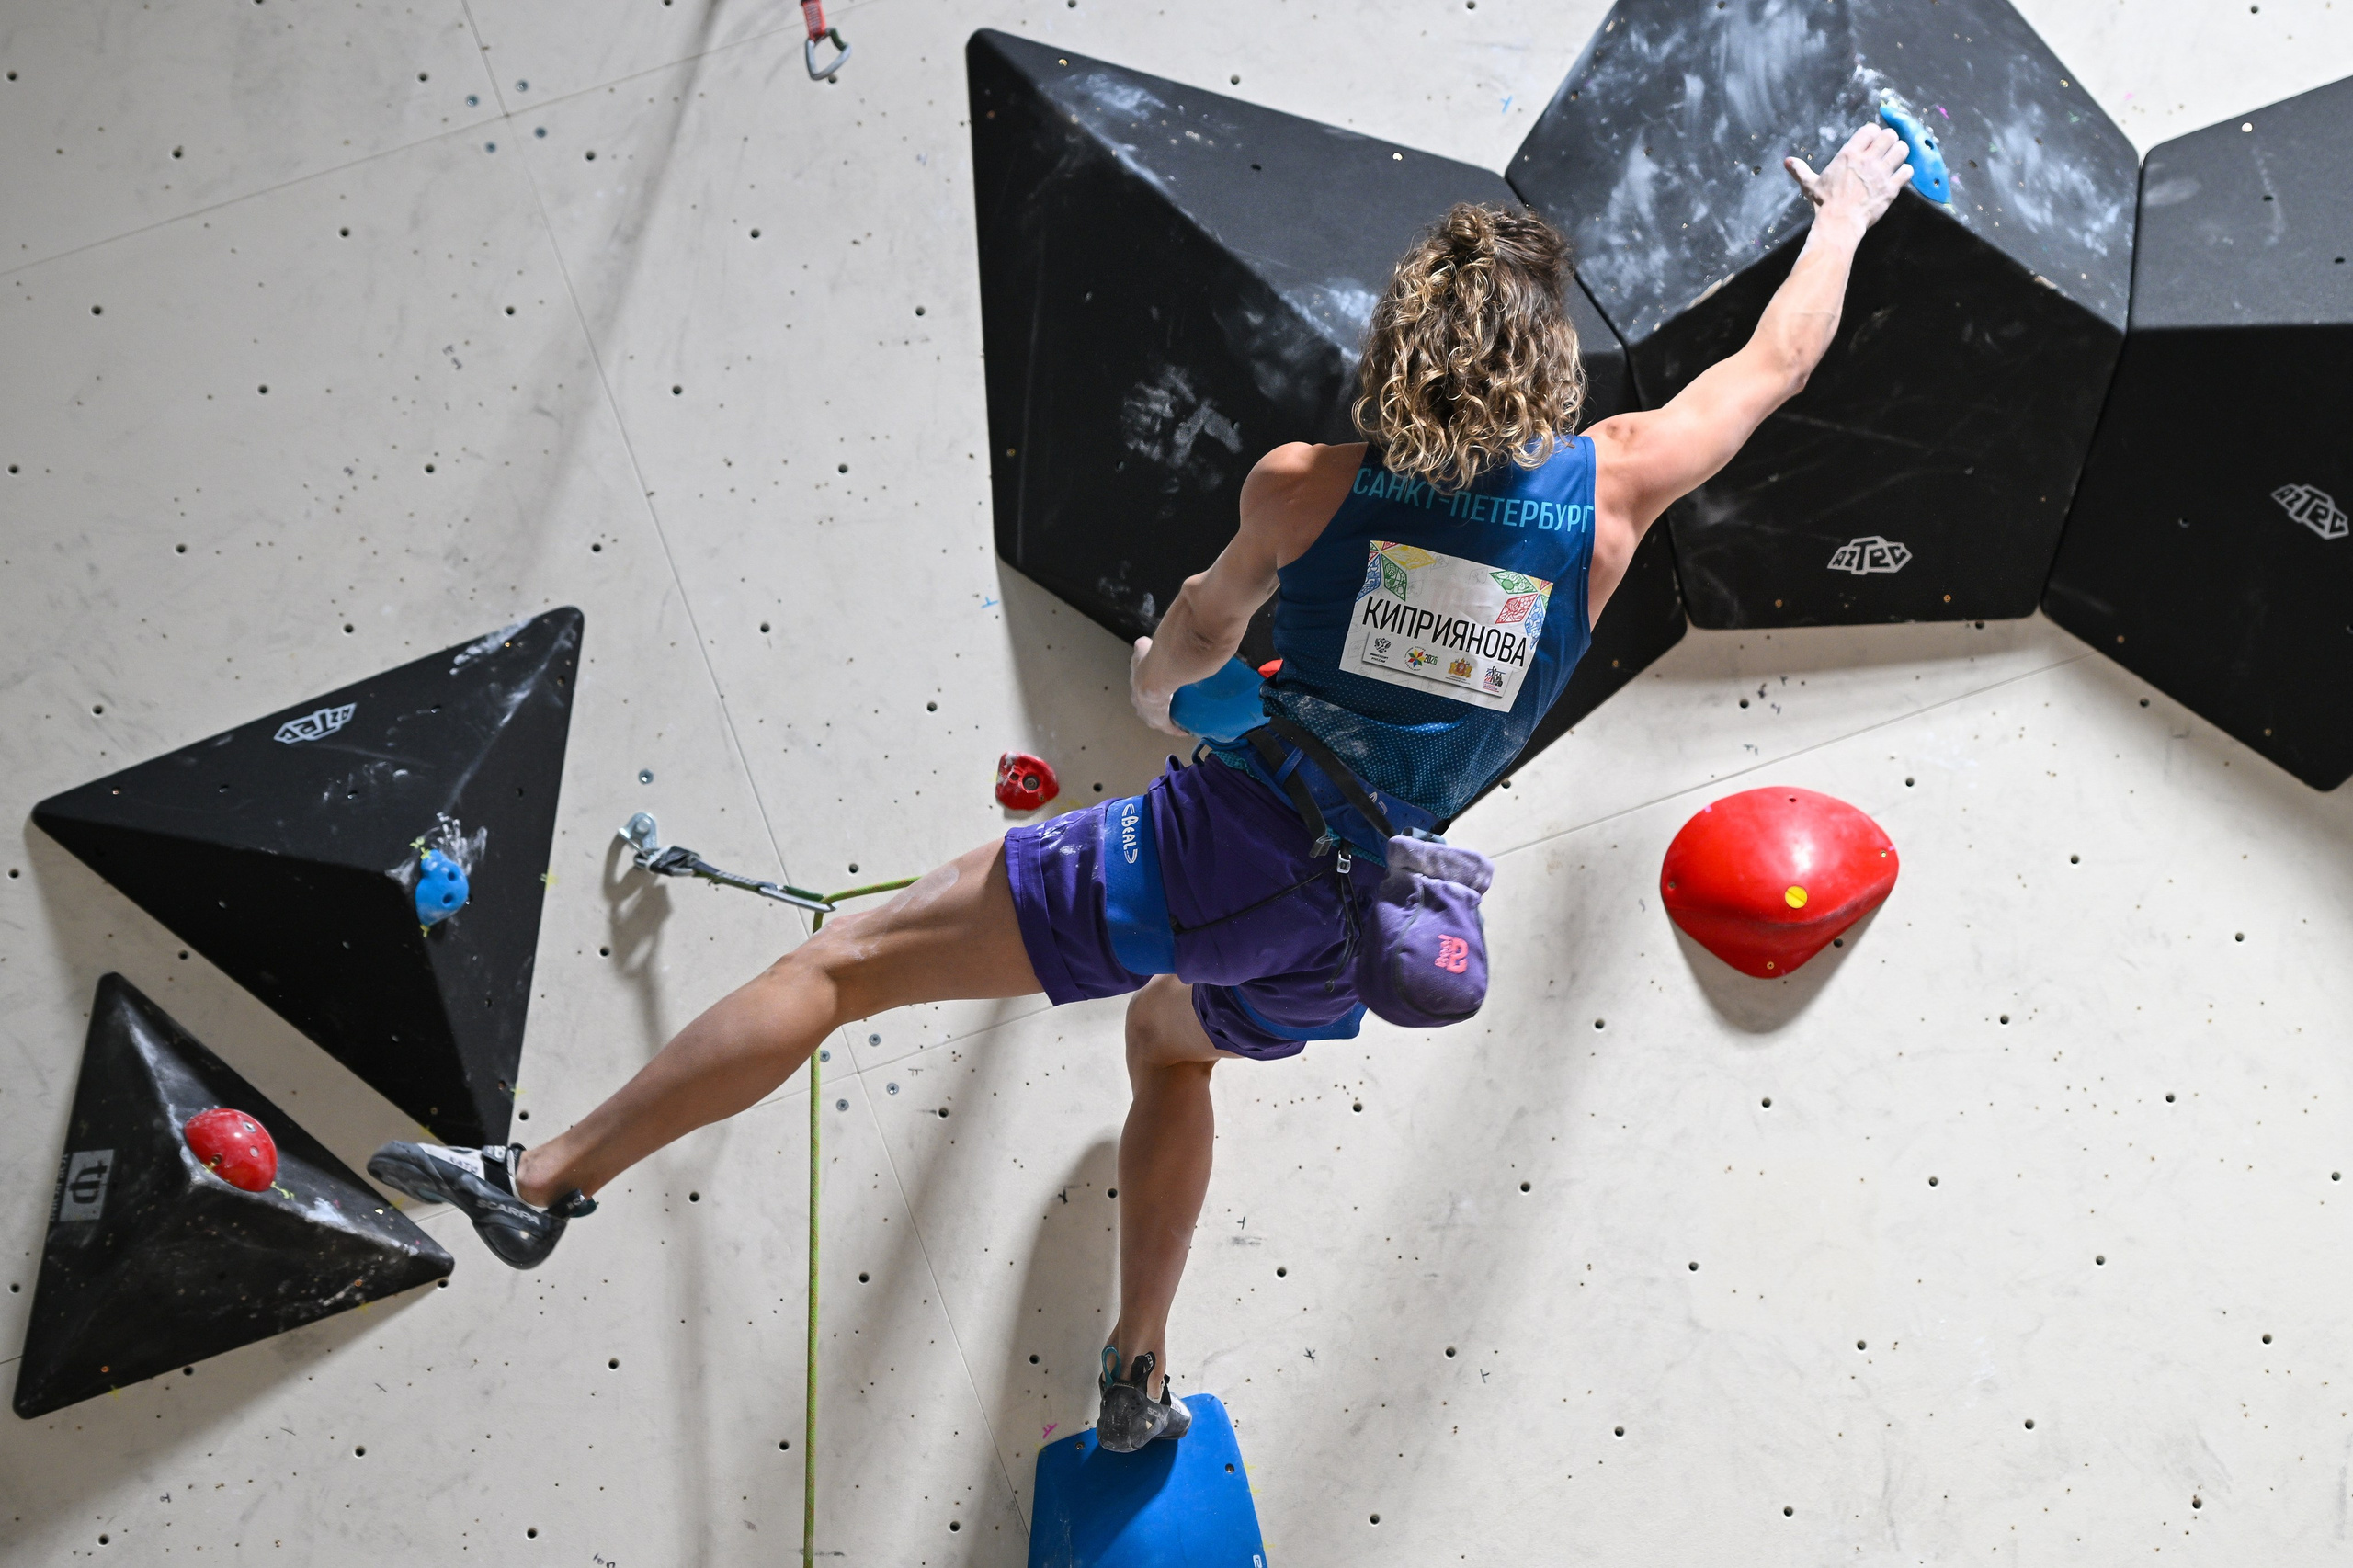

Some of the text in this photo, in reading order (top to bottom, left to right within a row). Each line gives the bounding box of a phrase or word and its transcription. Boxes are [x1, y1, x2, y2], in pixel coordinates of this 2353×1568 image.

[1352, 467, 1594, 533] САНКТ-ПЕТЕРБУРГ
[1362, 596, 1528, 667] КИПРИЯНОВА
[475, 1199, 541, 1227] SCARPA
